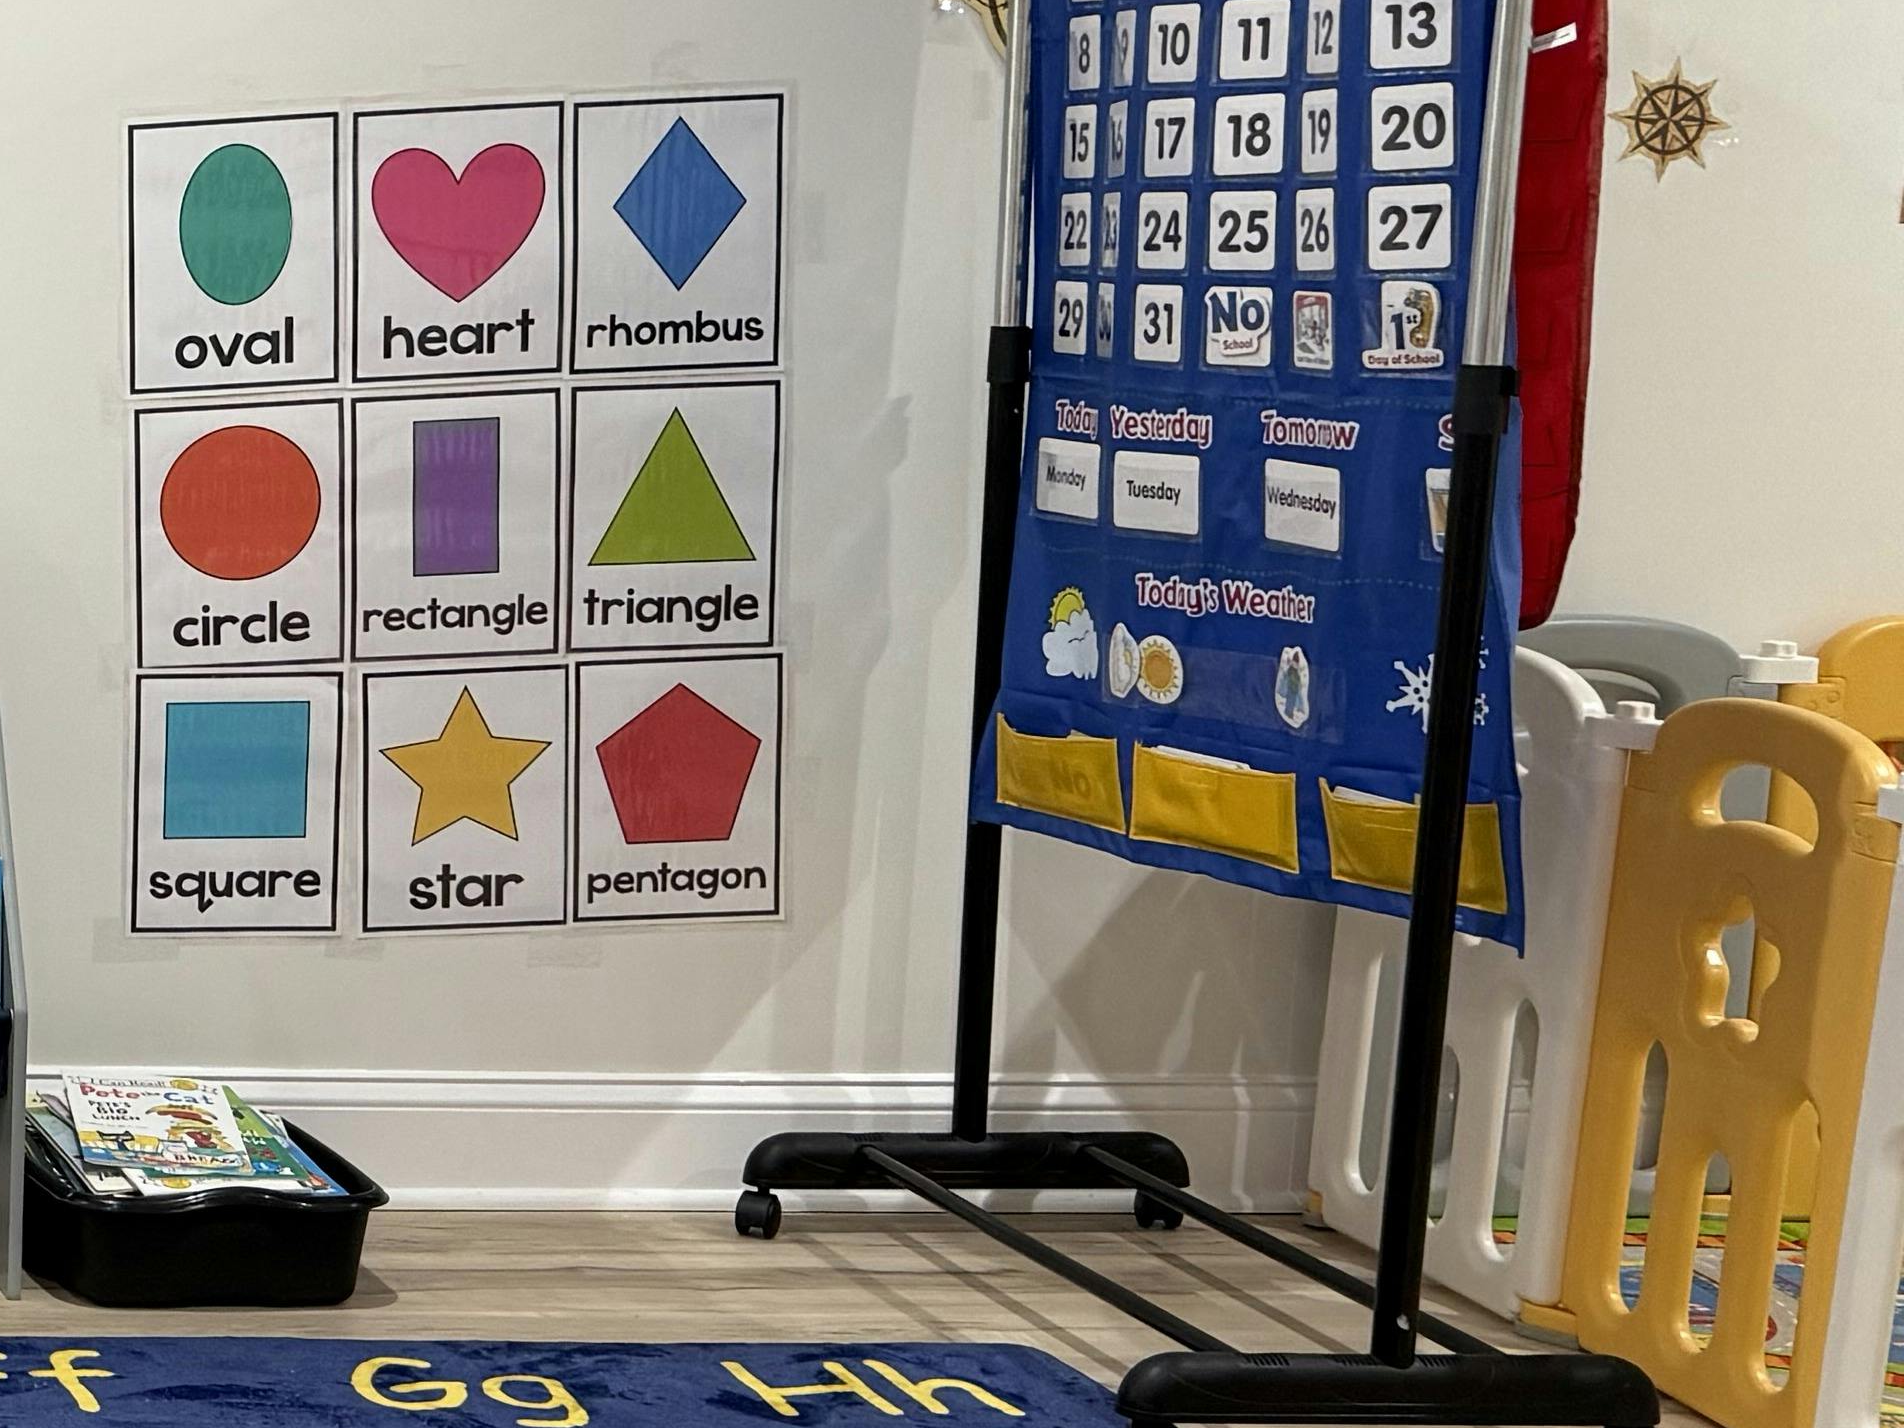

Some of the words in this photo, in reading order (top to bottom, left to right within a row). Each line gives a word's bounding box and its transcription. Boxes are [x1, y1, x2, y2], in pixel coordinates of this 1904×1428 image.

[1384, 1, 1438, 50] 13
[1381, 102, 1447, 152] 20
[1217, 209, 1269, 254] 25
[383, 308, 536, 360] heart
[586, 310, 765, 348] rhombus
[1211, 295, 1264, 333] No
[174, 315, 294, 369] oval
[1223, 337, 1253, 351] School
[1368, 355, 1388, 366] Day
[1392, 355, 1402, 364] of
[1404, 354, 1440, 364] School
[1110, 405, 1212, 450] Yesterday
[1125, 479, 1181, 507] Tuesday
[1266, 486, 1337, 520] Wednesday
[362, 593, 548, 636] rectangle
[583, 583, 759, 633] triangle
[1135, 573, 1218, 617] Today's
[1222, 579, 1315, 623] Weather
[172, 600, 311, 648] circle
[149, 869, 321, 914] square
[409, 863, 525, 911] star
[587, 861, 767, 905] pentagon
[350, 1356, 589, 1428] Gg
[720, 1358, 1026, 1418] Hh
